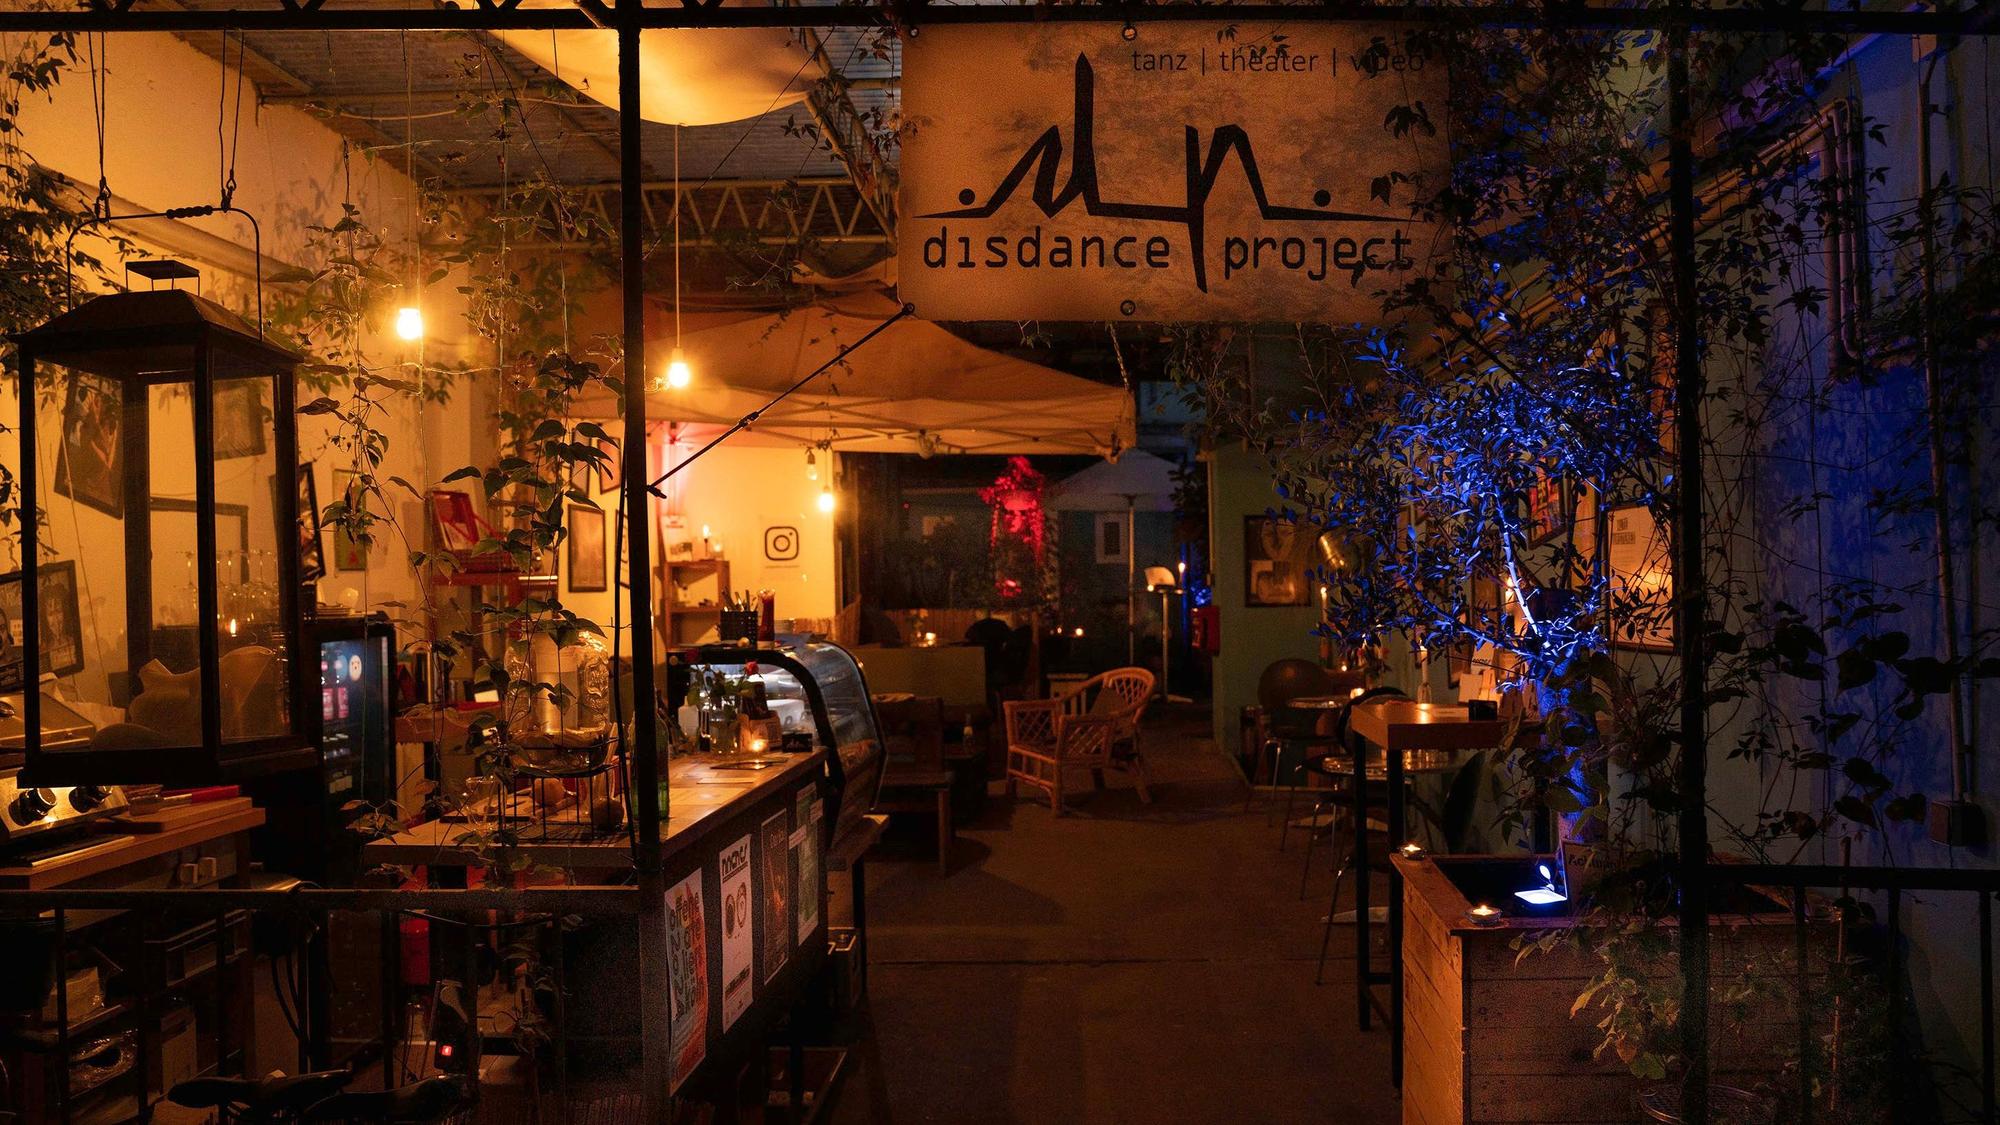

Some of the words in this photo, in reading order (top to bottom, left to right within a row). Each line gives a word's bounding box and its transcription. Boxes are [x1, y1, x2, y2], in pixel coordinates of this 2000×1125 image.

[1132, 50, 1188, 71] tanz
[1219, 48, 1319, 71] theater
[1350, 46, 1425, 71] vdeo
[923, 226, 1171, 268] disdance
[1224, 229, 1414, 281] project
